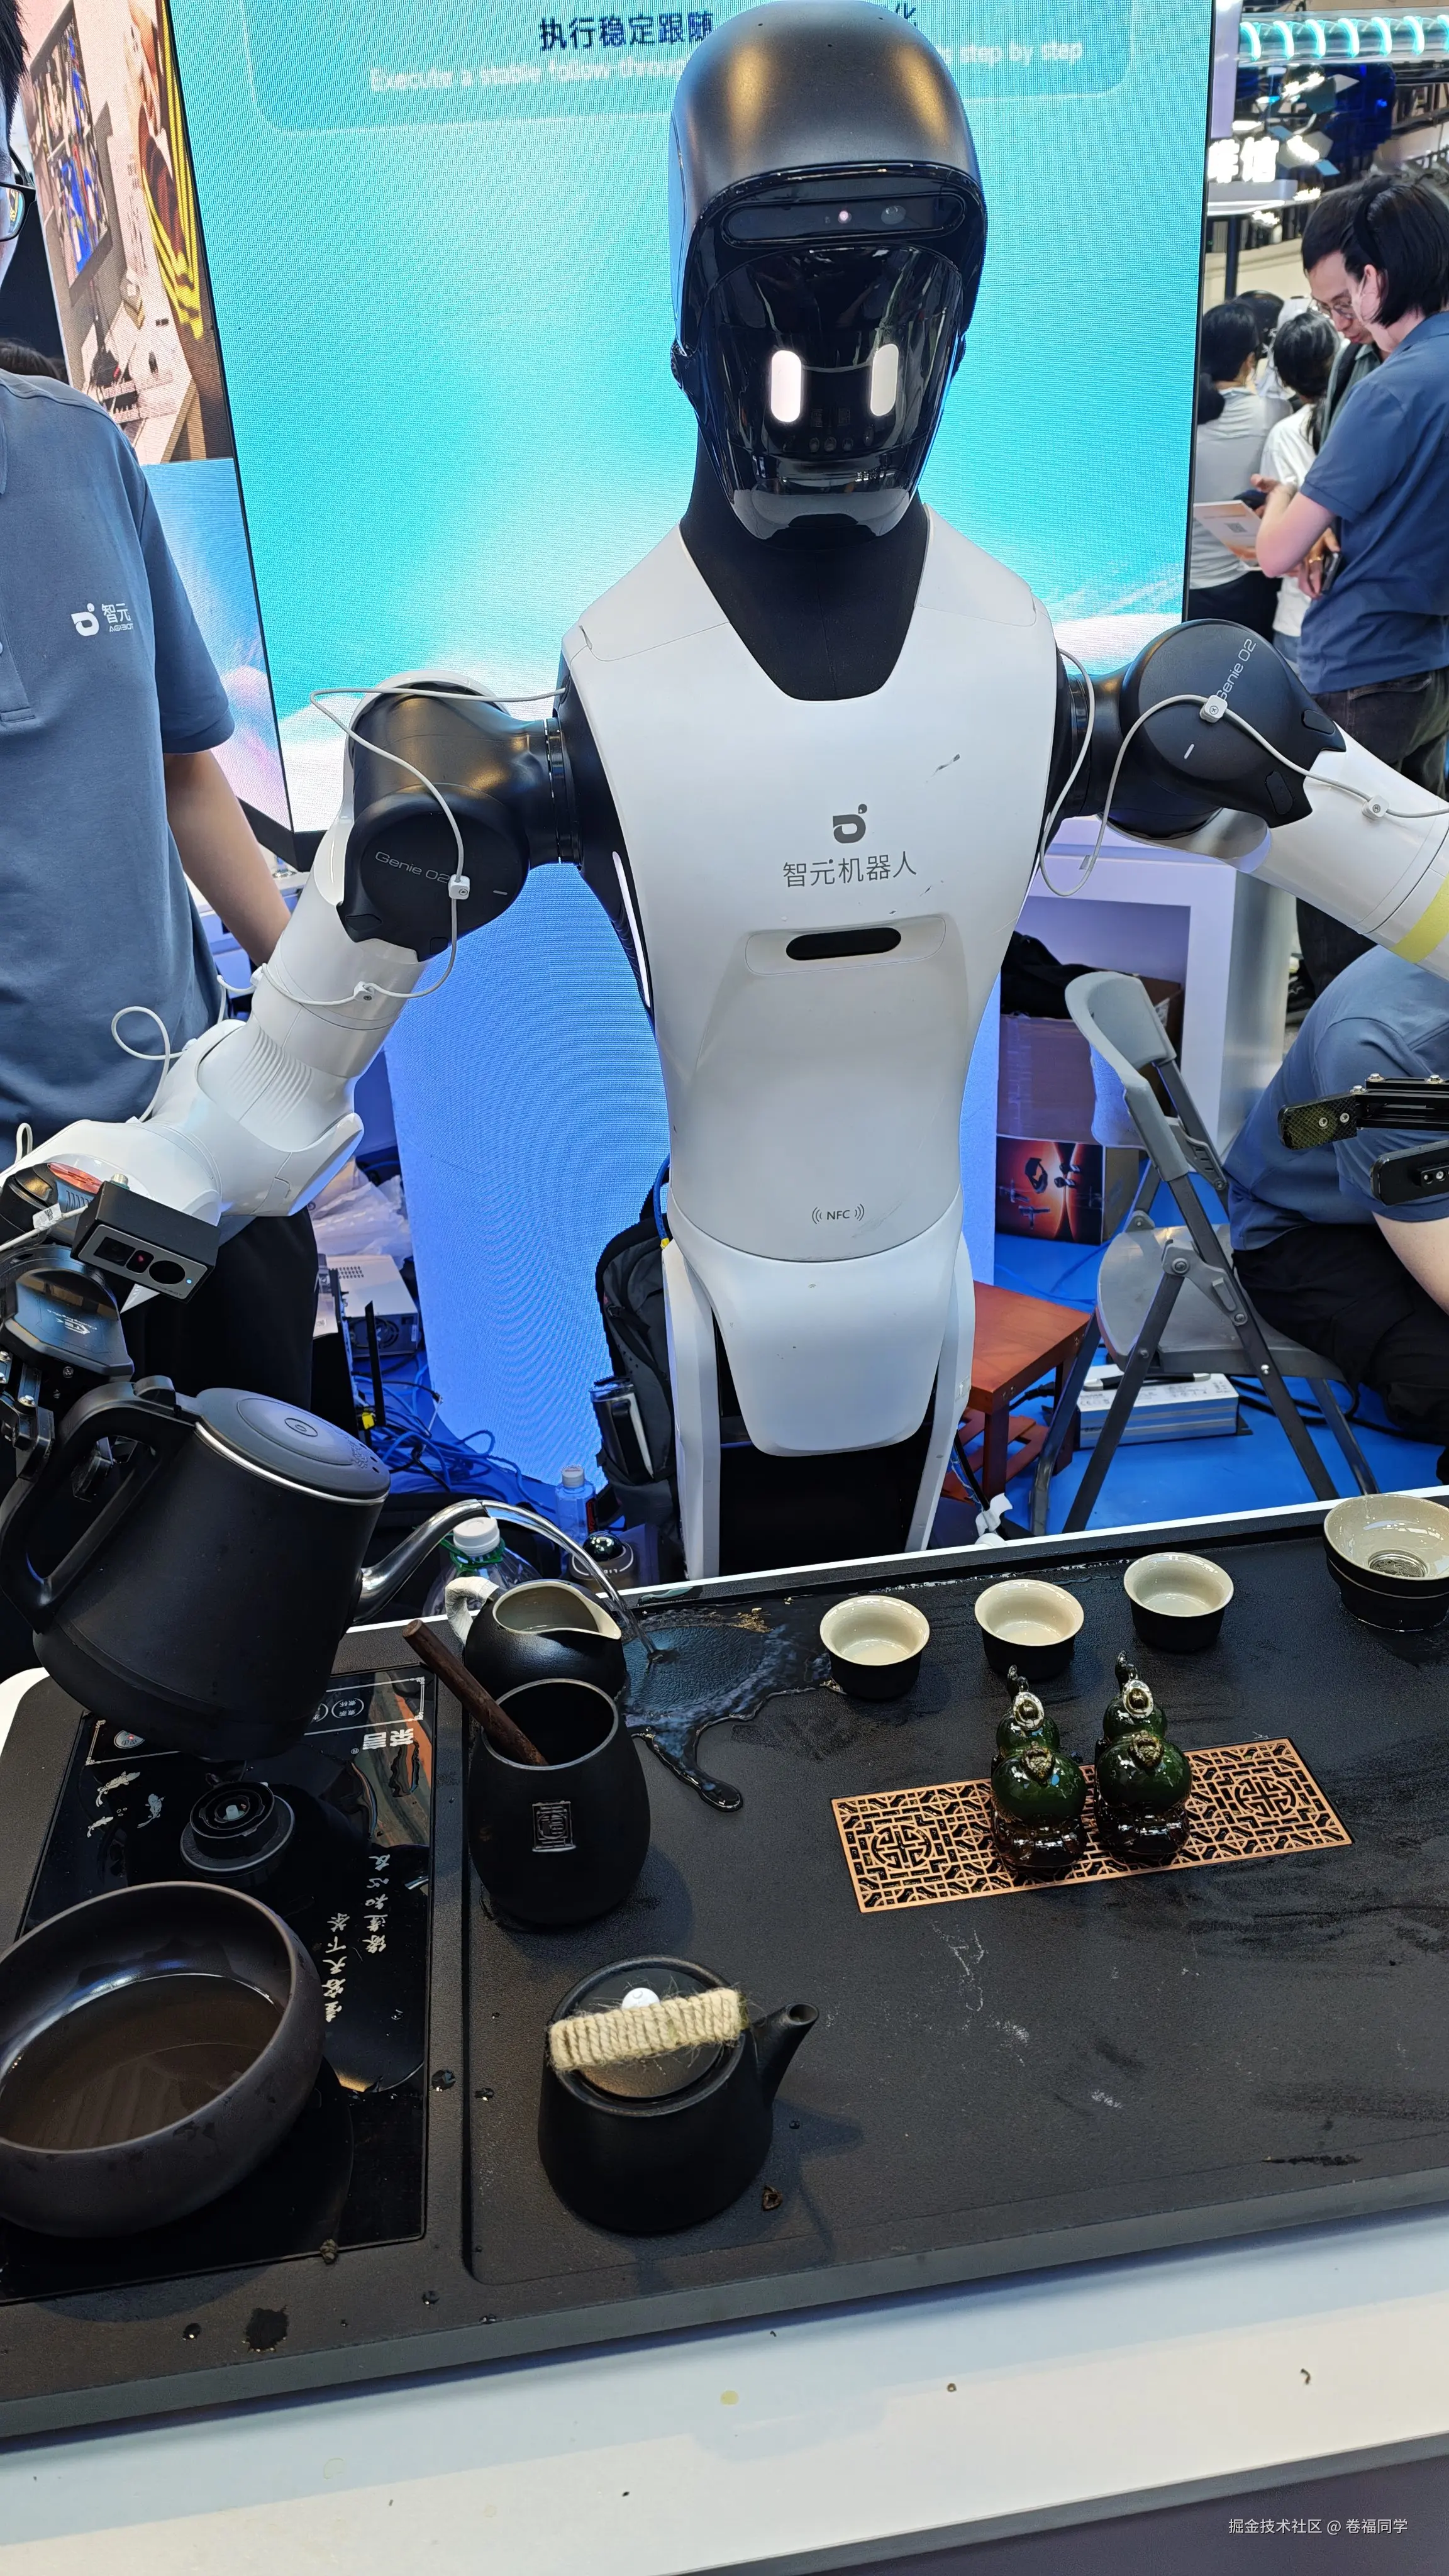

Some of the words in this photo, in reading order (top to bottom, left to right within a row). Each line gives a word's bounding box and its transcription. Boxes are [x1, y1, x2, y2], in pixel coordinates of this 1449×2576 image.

[540, 10, 713, 50] 执行稳定跟随
[959, 43, 1002, 67] step
[1009, 40, 1034, 65] by
[1041, 41, 1084, 65] step
[370, 67, 453, 91] Execute
[461, 71, 472, 87] a
[480, 62, 541, 85] stable
[549, 55, 688, 82] follow-throug
[101, 602, 131, 624] 智元
[1216, 663, 1244, 701] Genie
[375, 851, 422, 875] Genie
[782, 850, 917, 887] 智元机器人
[826, 1209, 850, 1220] NFC
